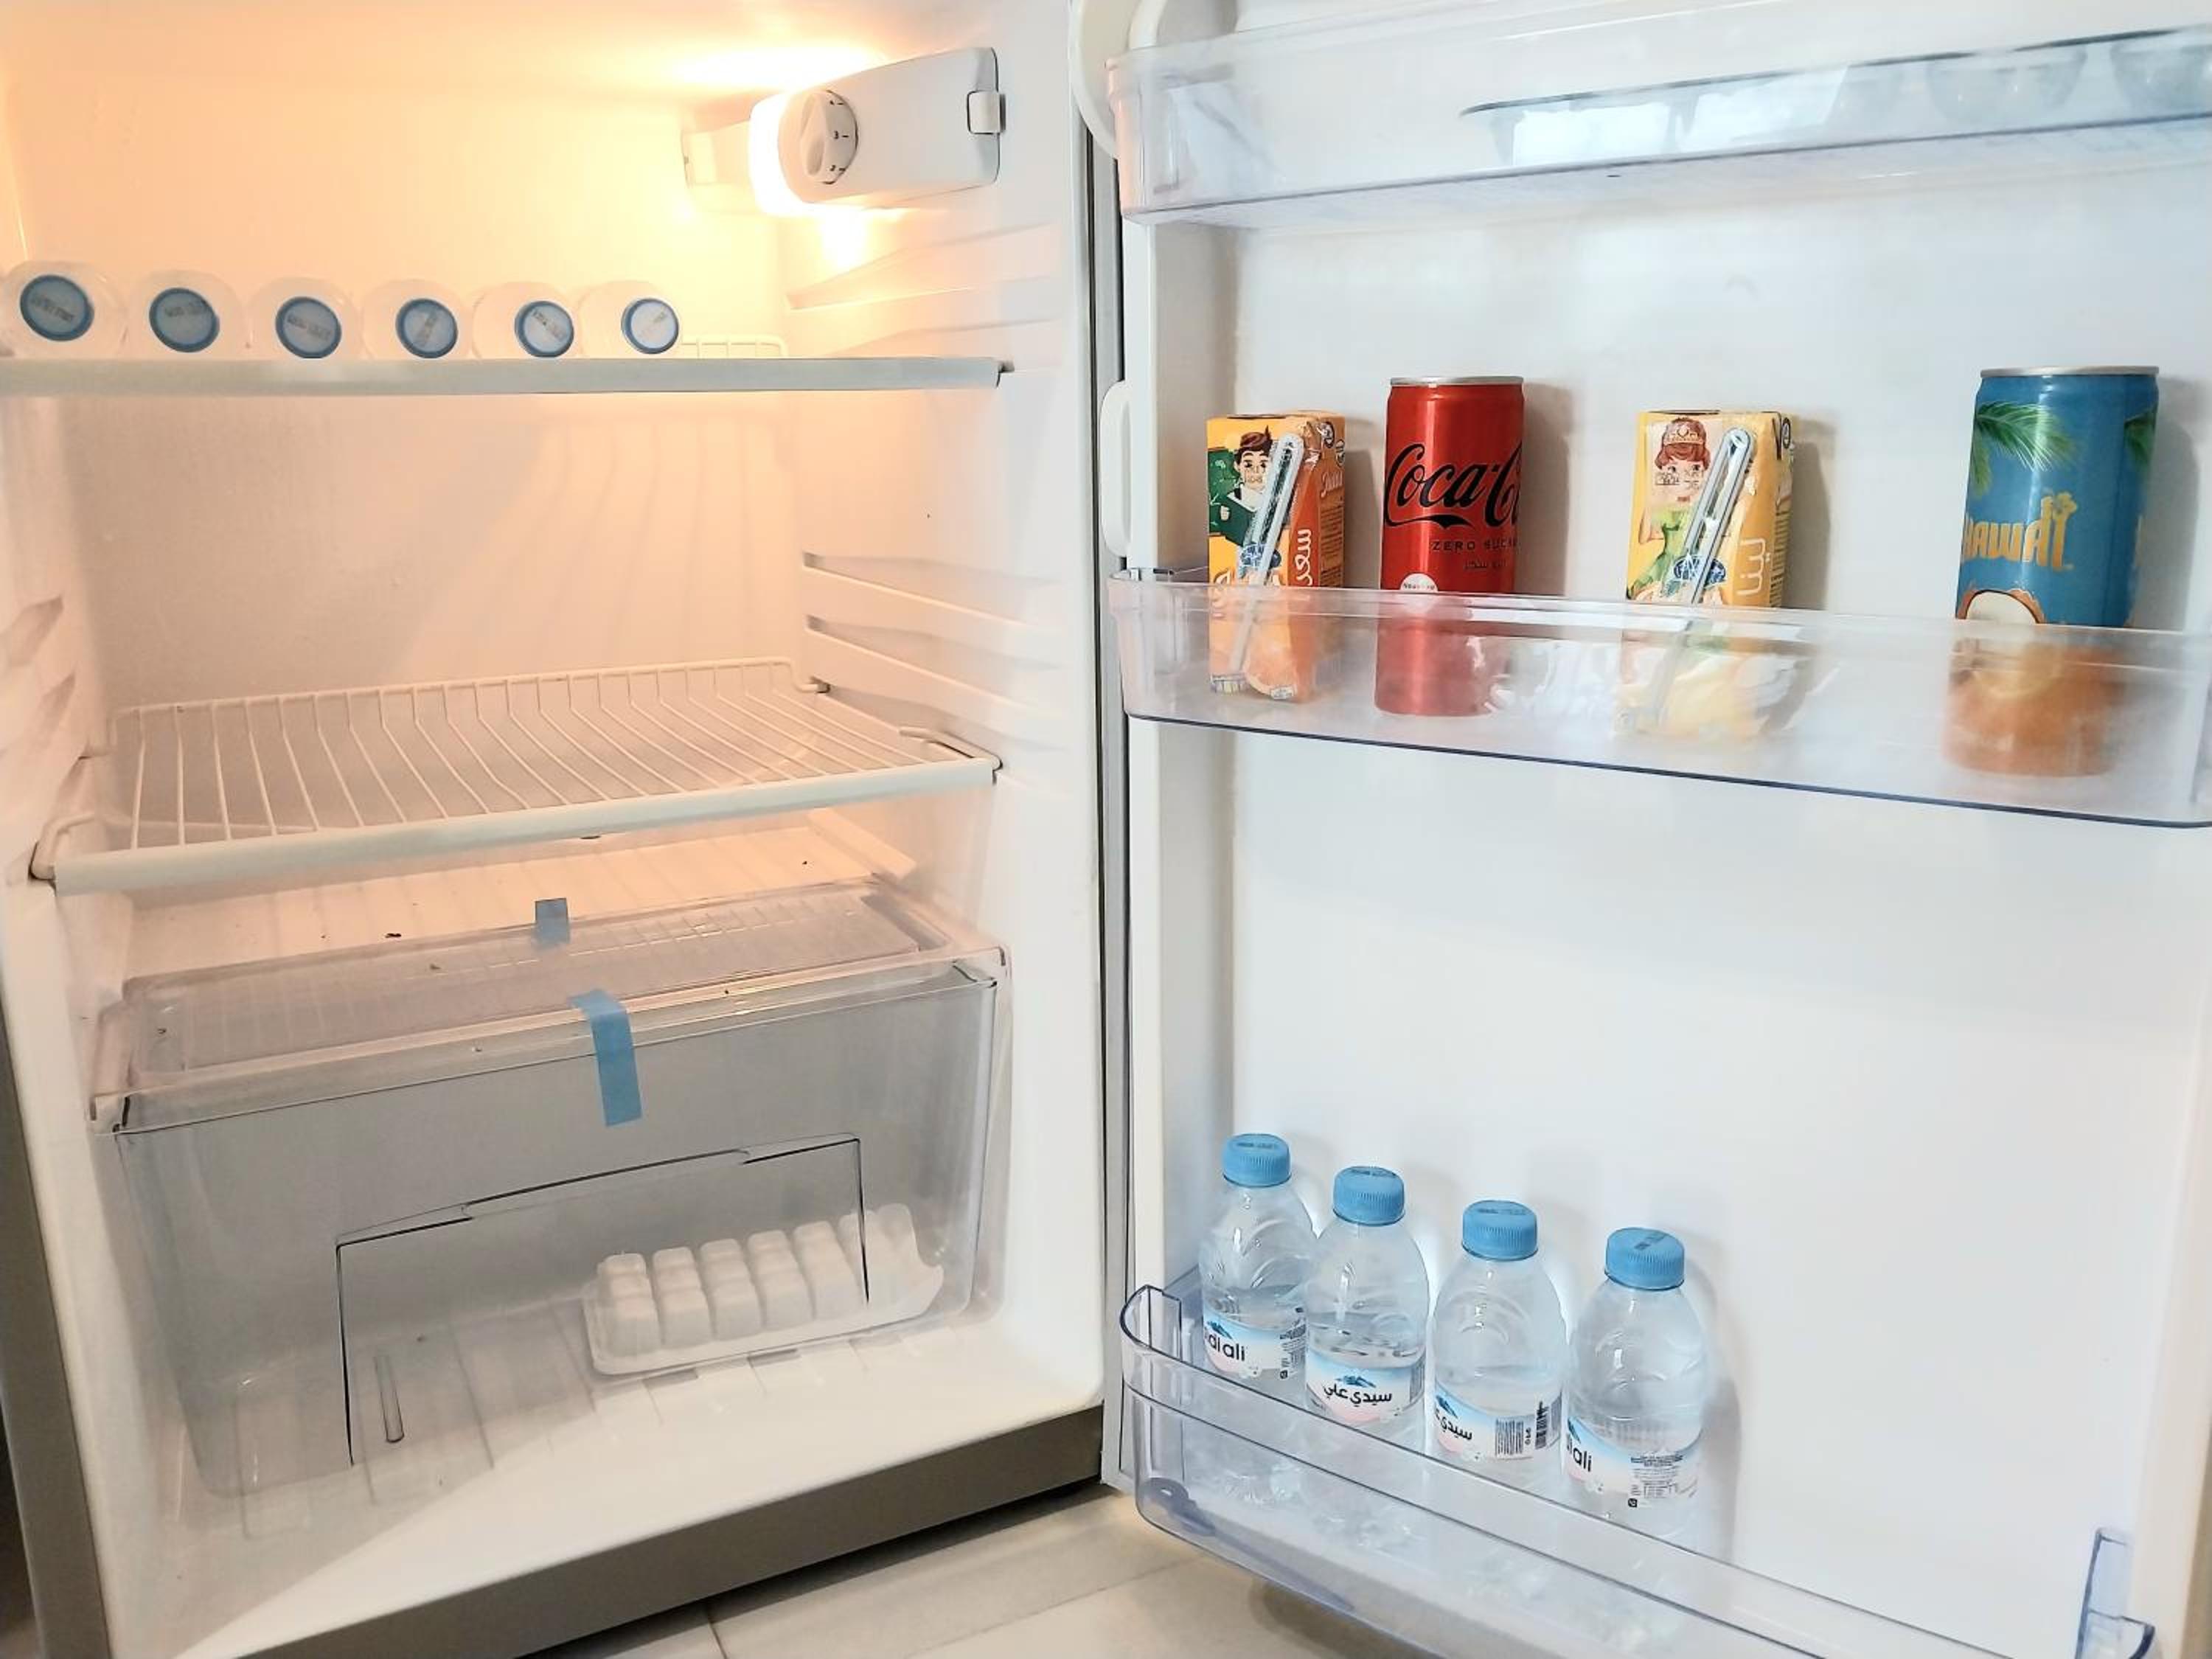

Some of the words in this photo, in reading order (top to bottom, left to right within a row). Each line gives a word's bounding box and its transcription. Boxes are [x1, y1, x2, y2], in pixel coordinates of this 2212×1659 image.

[1432, 540, 1476, 552] ZERO
[1222, 1343, 1245, 1362] ali
[1322, 1382, 1349, 1399] علي
[1349, 1391, 1393, 1408] سيدي
[1440, 1416, 1473, 1440] سيدي
[1573, 1447, 1593, 1472] ali
